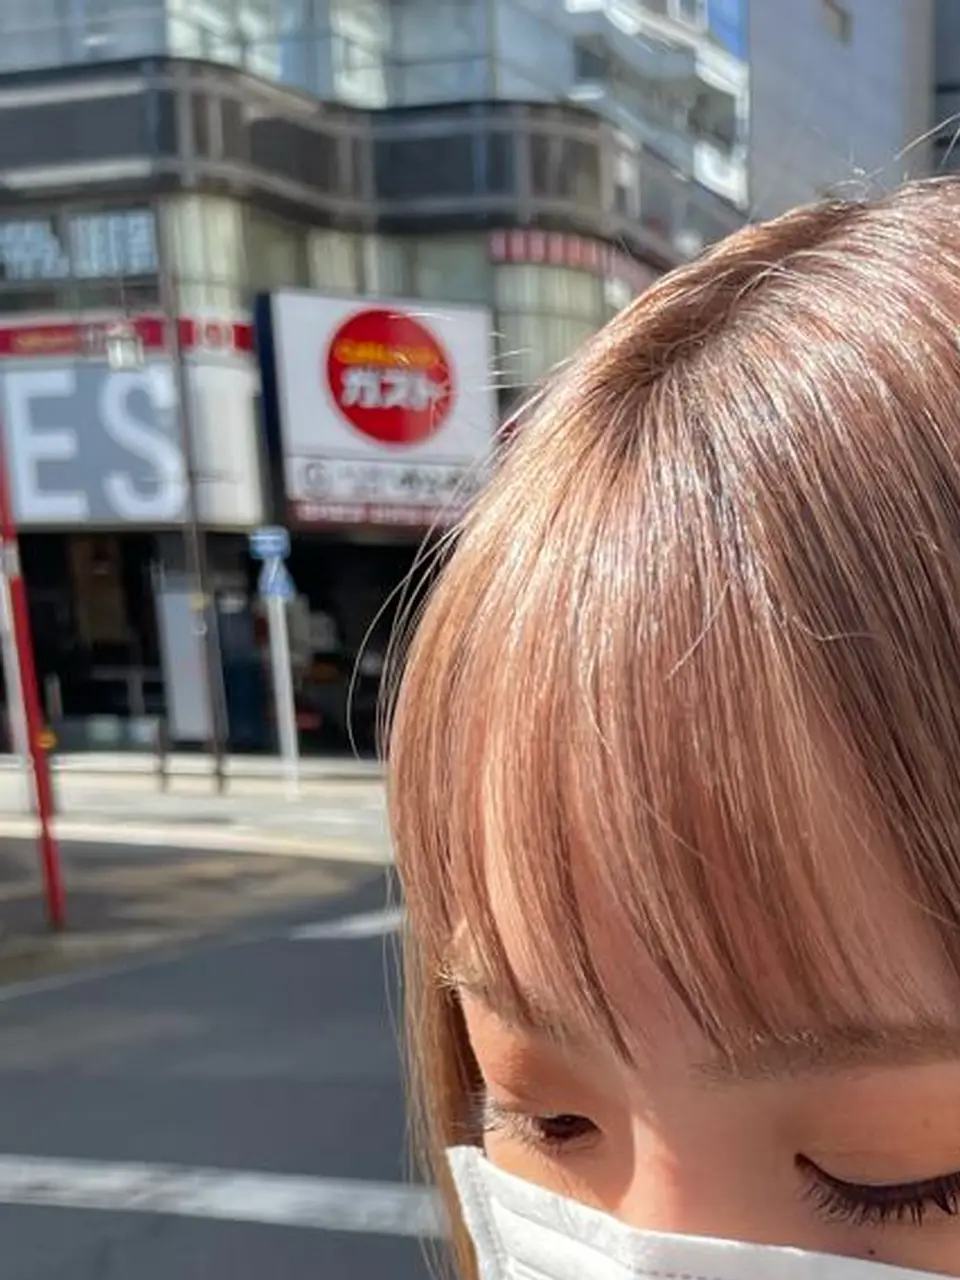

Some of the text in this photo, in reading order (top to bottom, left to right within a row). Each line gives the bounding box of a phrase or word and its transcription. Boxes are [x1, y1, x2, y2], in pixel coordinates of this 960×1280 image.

[340, 366, 442, 412] ガスト
[4, 365, 188, 523] ES
